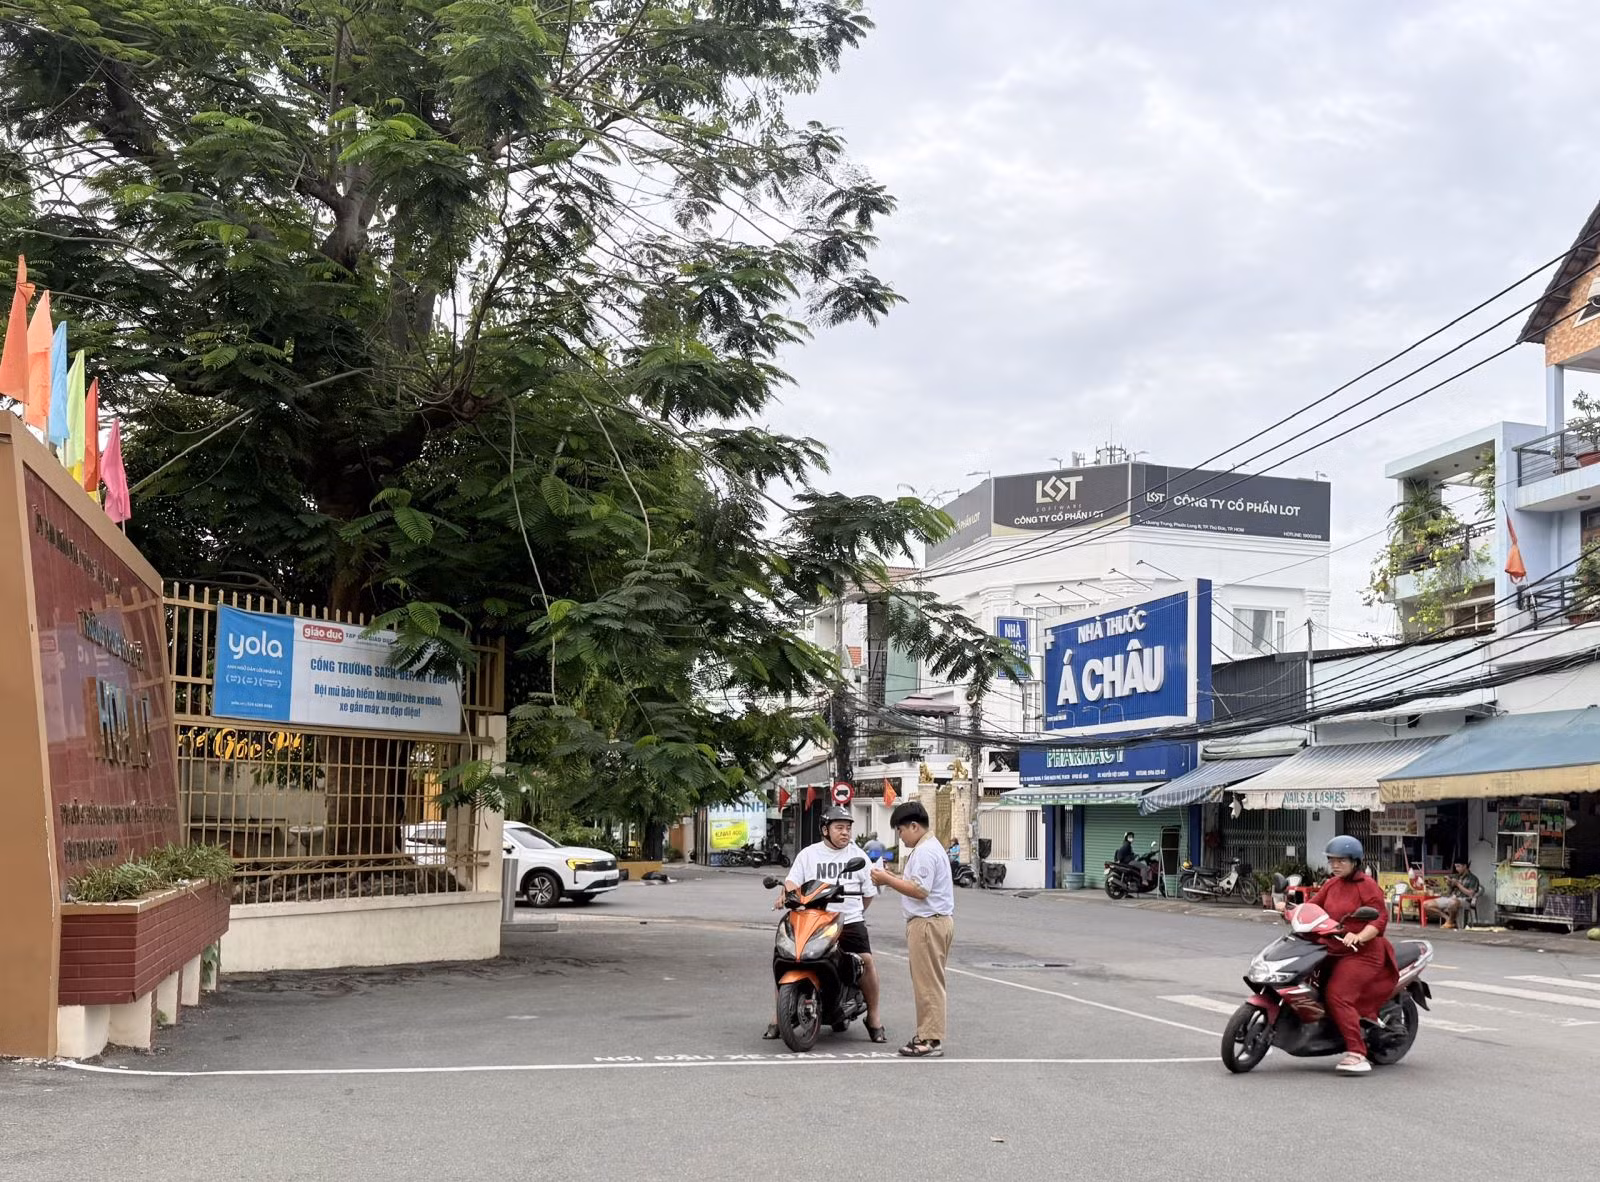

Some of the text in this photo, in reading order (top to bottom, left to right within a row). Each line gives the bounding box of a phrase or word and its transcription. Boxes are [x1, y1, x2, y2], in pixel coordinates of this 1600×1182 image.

[1173, 494, 1300, 517] CÔNG TY CỔ PHẦN LOT
[1014, 515, 1038, 525] CÔNG
[1039, 515, 1049, 523] TY
[1051, 511, 1063, 522] CỔ
[304, 626, 343, 640] giáo dục
[1004, 621, 1021, 638] NHÀ
[1078, 606, 1147, 644] NHÀ THUỐC
[228, 630, 283, 660] yola
[337, 660, 373, 677] TRƯỜNG
[1056, 639, 1165, 706] Á CHÂU
[314, 684, 327, 698] Đội
[328, 684, 340, 697] mũ
[341, 685, 355, 699] bảo
[356, 686, 375, 700] hiểm
[376, 688, 387, 701] khi
[387, 690, 402, 704] ngồi
[402, 692, 416, 704] trên
[416, 695, 425, 705] xe
[339, 702, 349, 712] xe
[350, 701, 363, 713] gắn
[381, 705, 390, 715] xe
[390, 705, 403, 718] đạp
[1283, 791, 1346, 804] NAILS & LASHES
